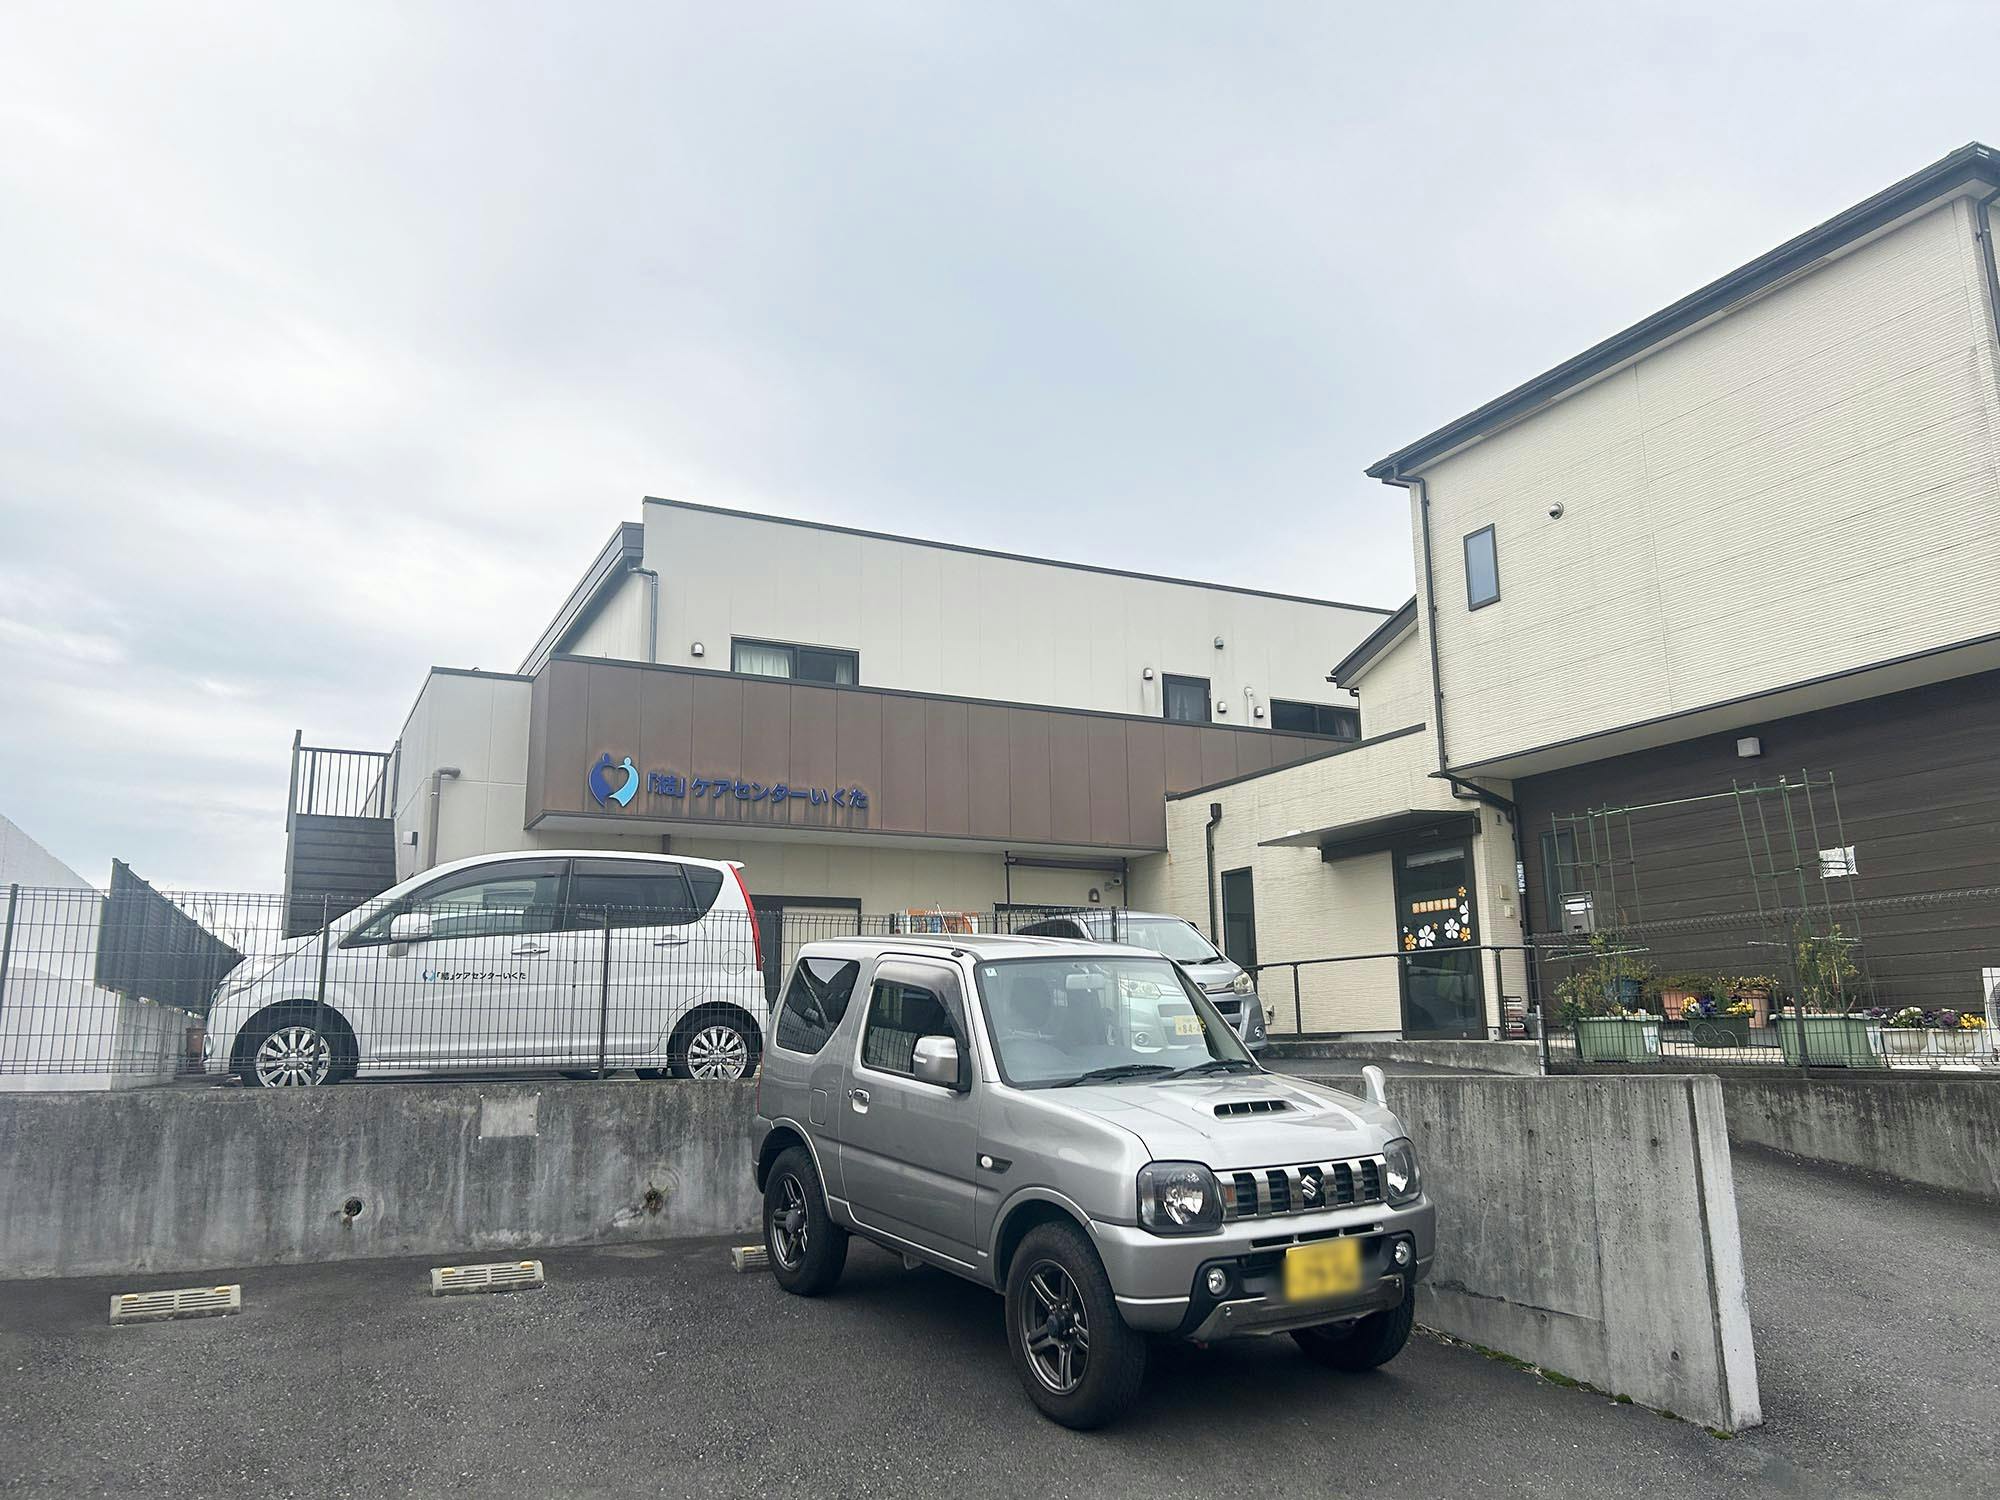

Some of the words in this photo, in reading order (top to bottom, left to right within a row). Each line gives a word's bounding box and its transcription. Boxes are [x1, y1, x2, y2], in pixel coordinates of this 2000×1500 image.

[647, 771, 869, 809] 「結」ケアセンターいくた
